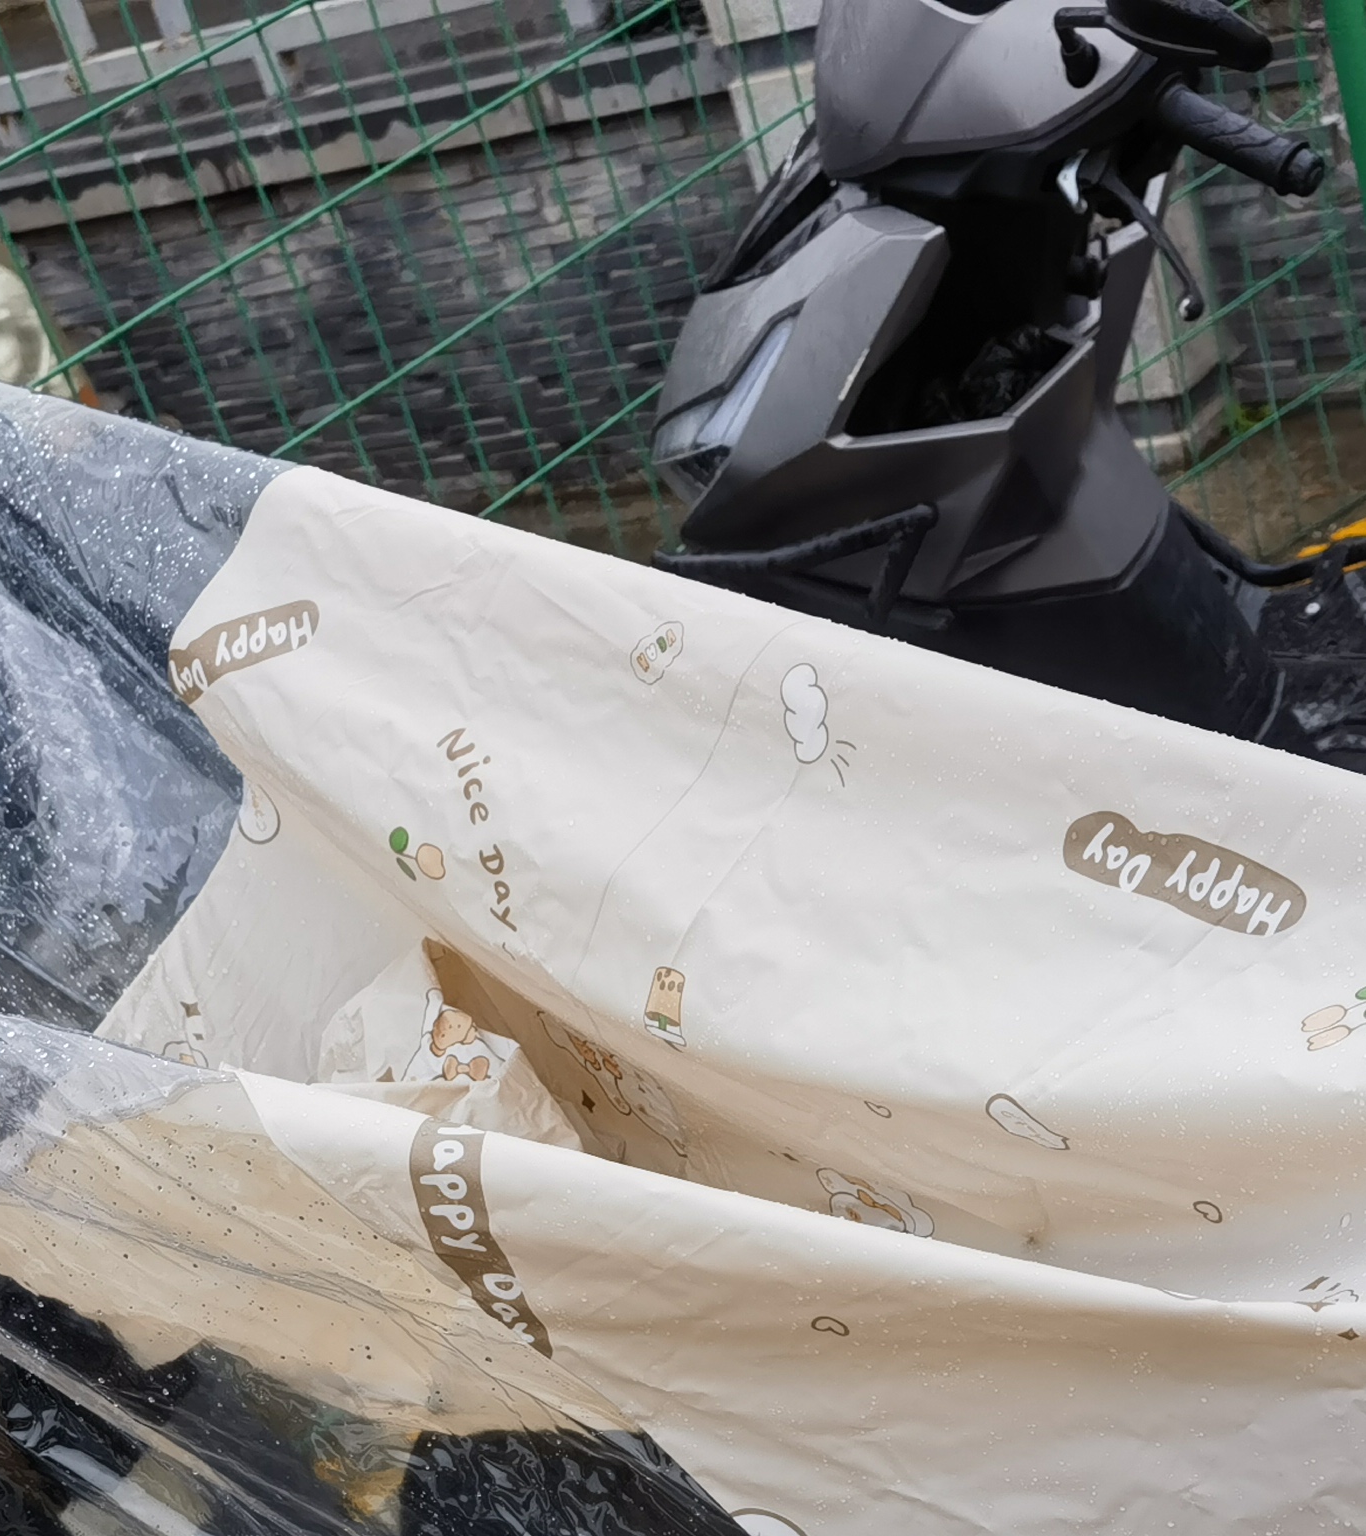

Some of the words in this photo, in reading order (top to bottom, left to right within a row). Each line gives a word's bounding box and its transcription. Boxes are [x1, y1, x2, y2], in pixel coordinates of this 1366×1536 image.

[214, 611, 316, 666] Happy
[170, 658, 210, 701] Day
[436, 727, 492, 826] Nice
[479, 843, 518, 933] Day
[1082, 822, 1153, 893] Day
[1164, 850, 1291, 936] Happy
[482, 1272, 536, 1344] Day
